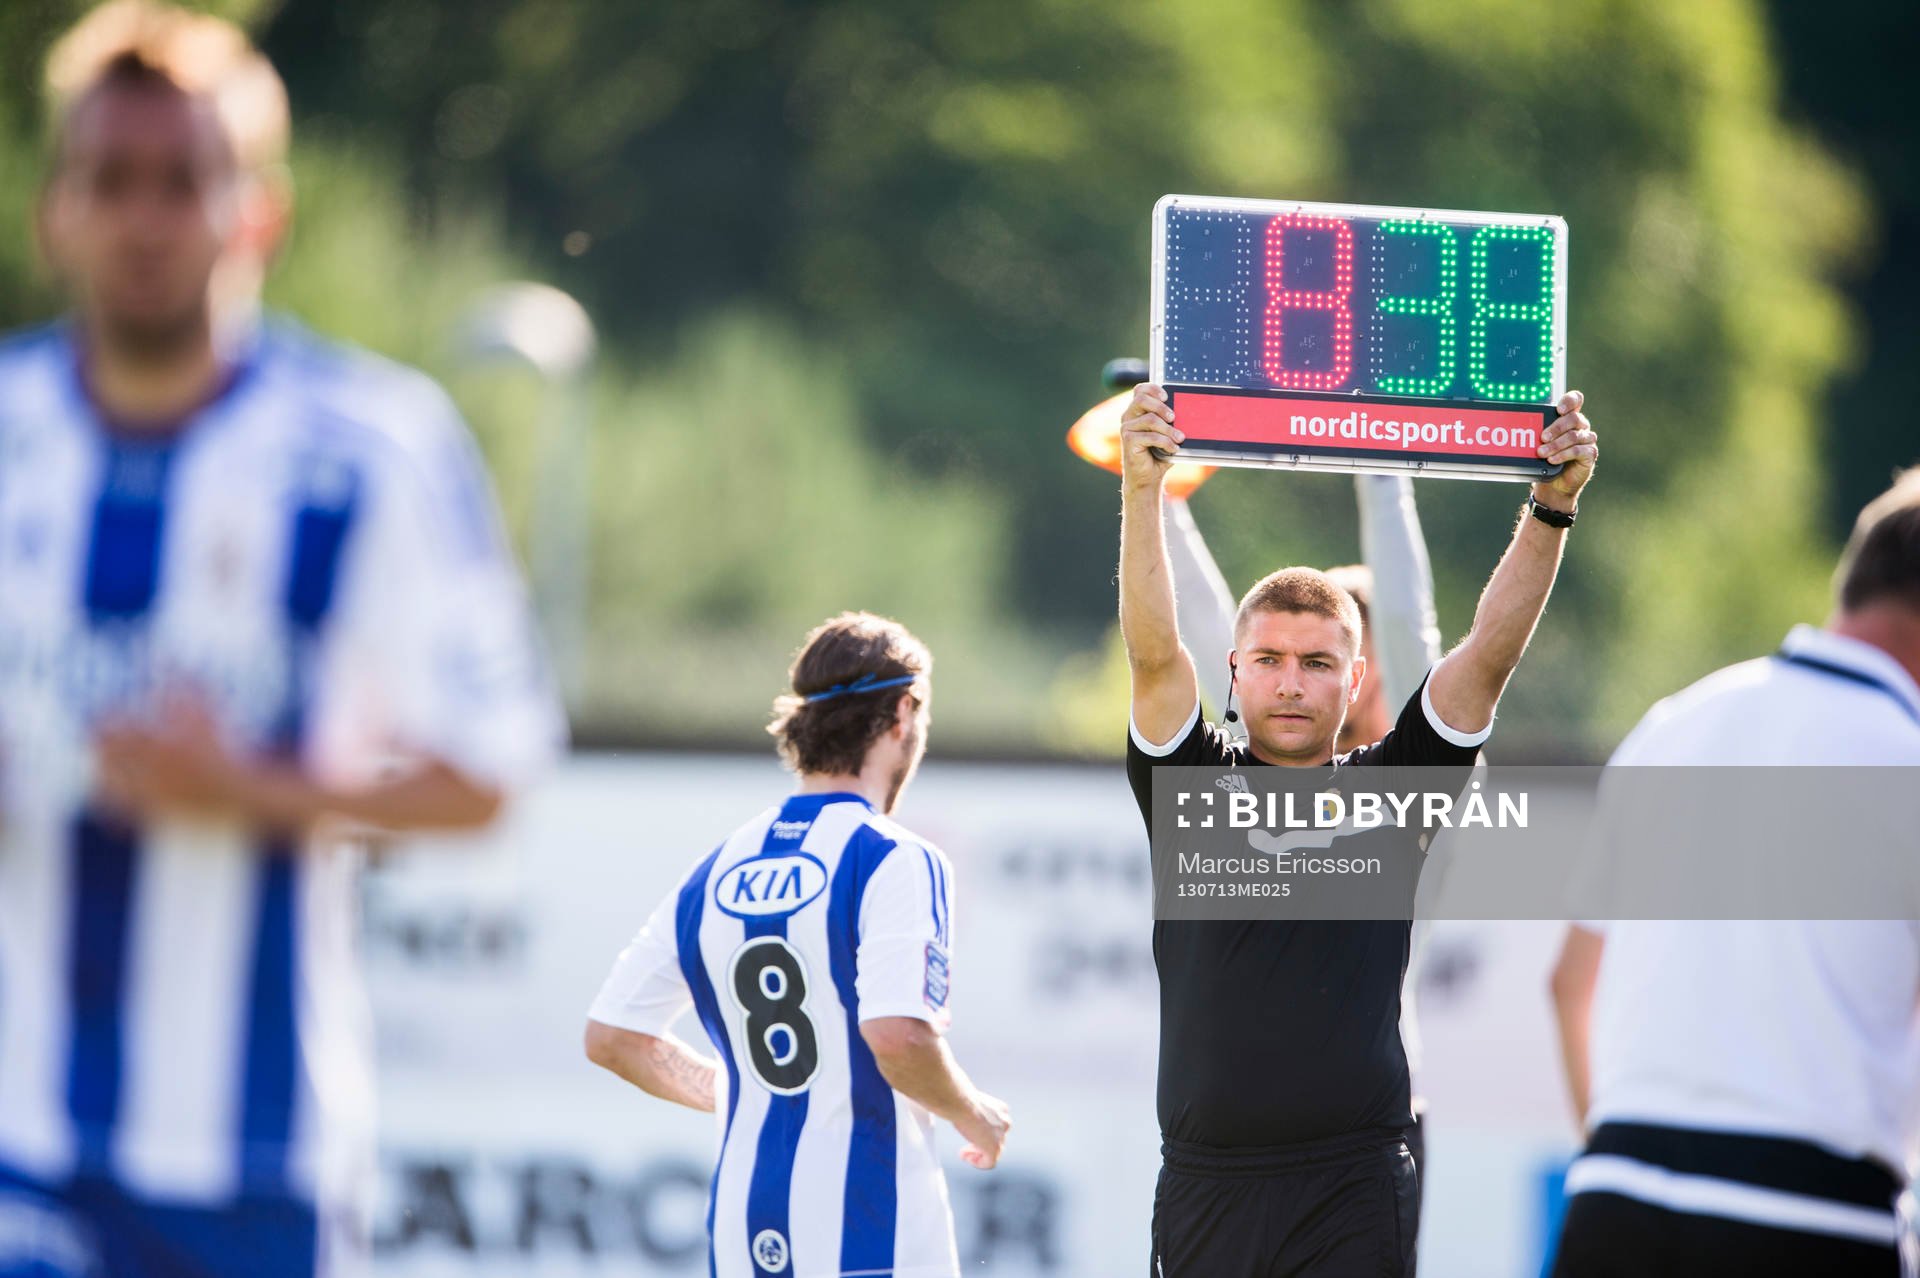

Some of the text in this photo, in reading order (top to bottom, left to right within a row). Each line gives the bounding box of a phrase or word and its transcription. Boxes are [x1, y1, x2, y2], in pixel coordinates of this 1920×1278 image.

[1265, 211, 1554, 400] 8 38
[1290, 411, 1536, 449] nordicsport.com
[733, 865, 802, 903] KIA
[731, 938, 819, 1092] 8
